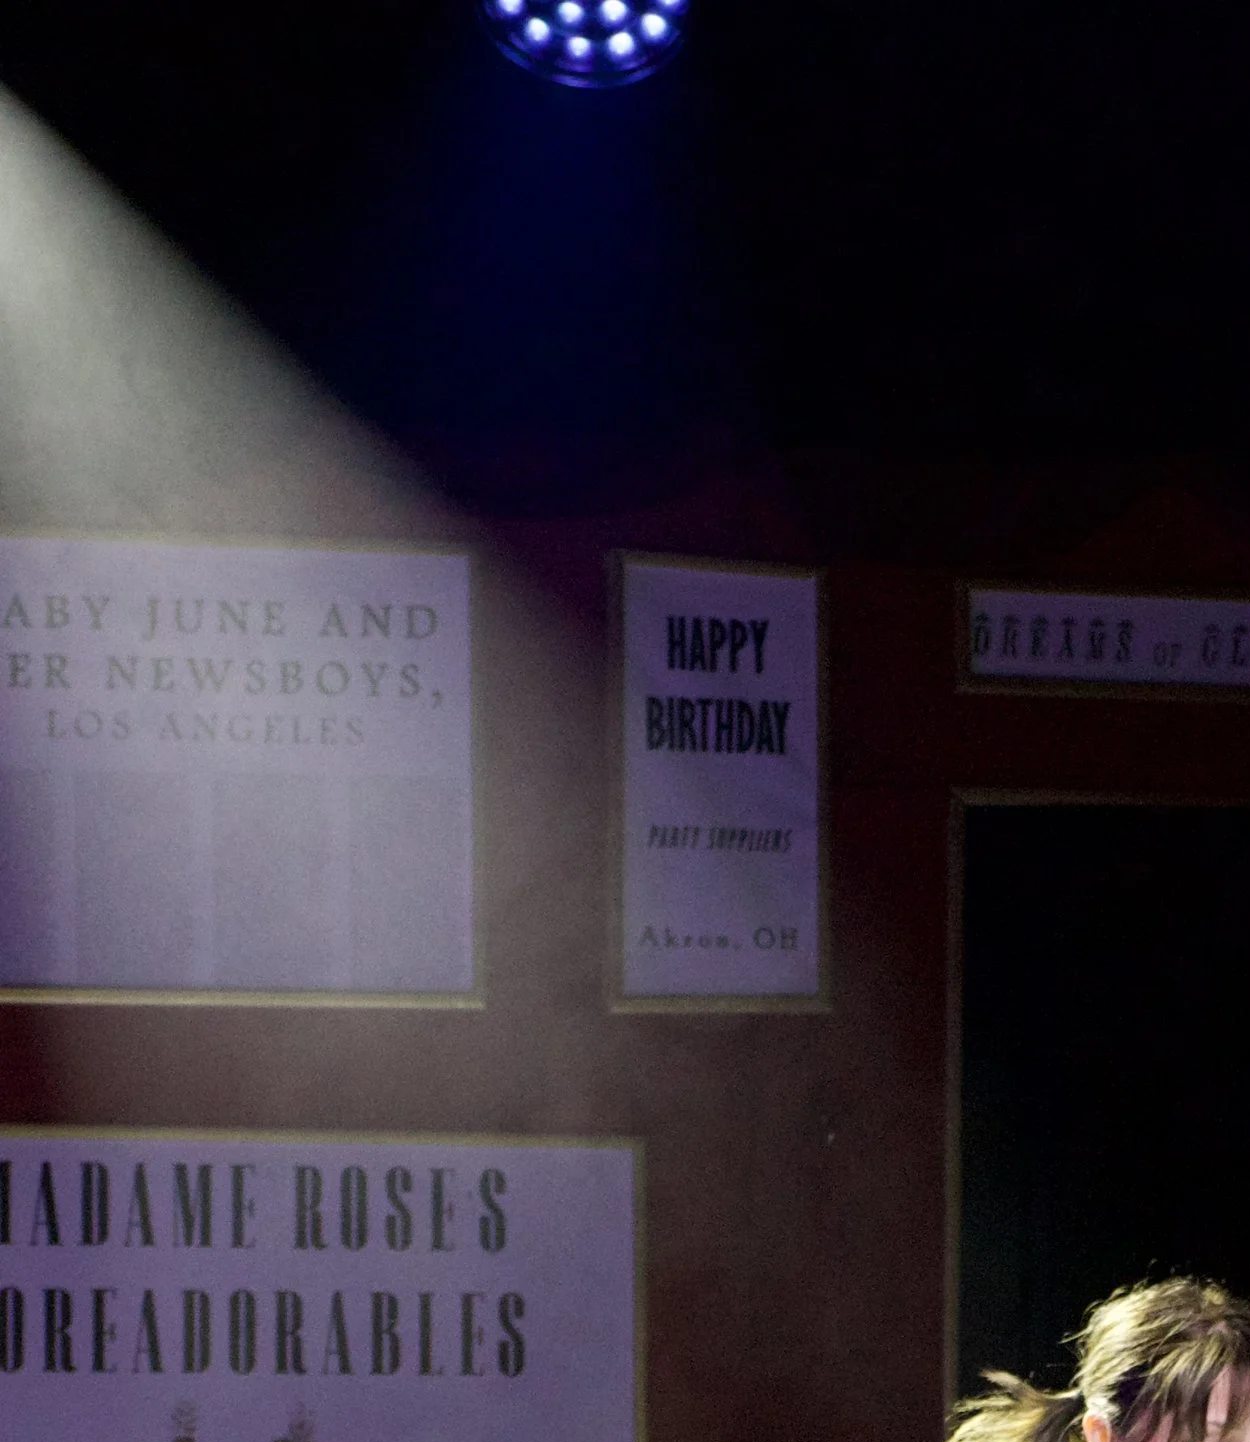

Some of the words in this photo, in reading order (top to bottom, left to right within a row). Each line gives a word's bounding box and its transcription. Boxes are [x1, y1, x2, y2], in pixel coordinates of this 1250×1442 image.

[2, 594, 110, 630] ABY
[141, 598, 288, 642] JUNE
[318, 602, 440, 640] AND
[667, 615, 769, 674] HAPPY
[7, 652, 72, 690] ER
[105, 656, 446, 710] NEWSBOYS,
[45, 708, 131, 740] LOS
[158, 712, 366, 746] ANGELES
[646, 696, 790, 755] BIRTHDAY
[753, 926, 798, 951] OH
[0, 1288, 526, 1378] OREADORABLES
